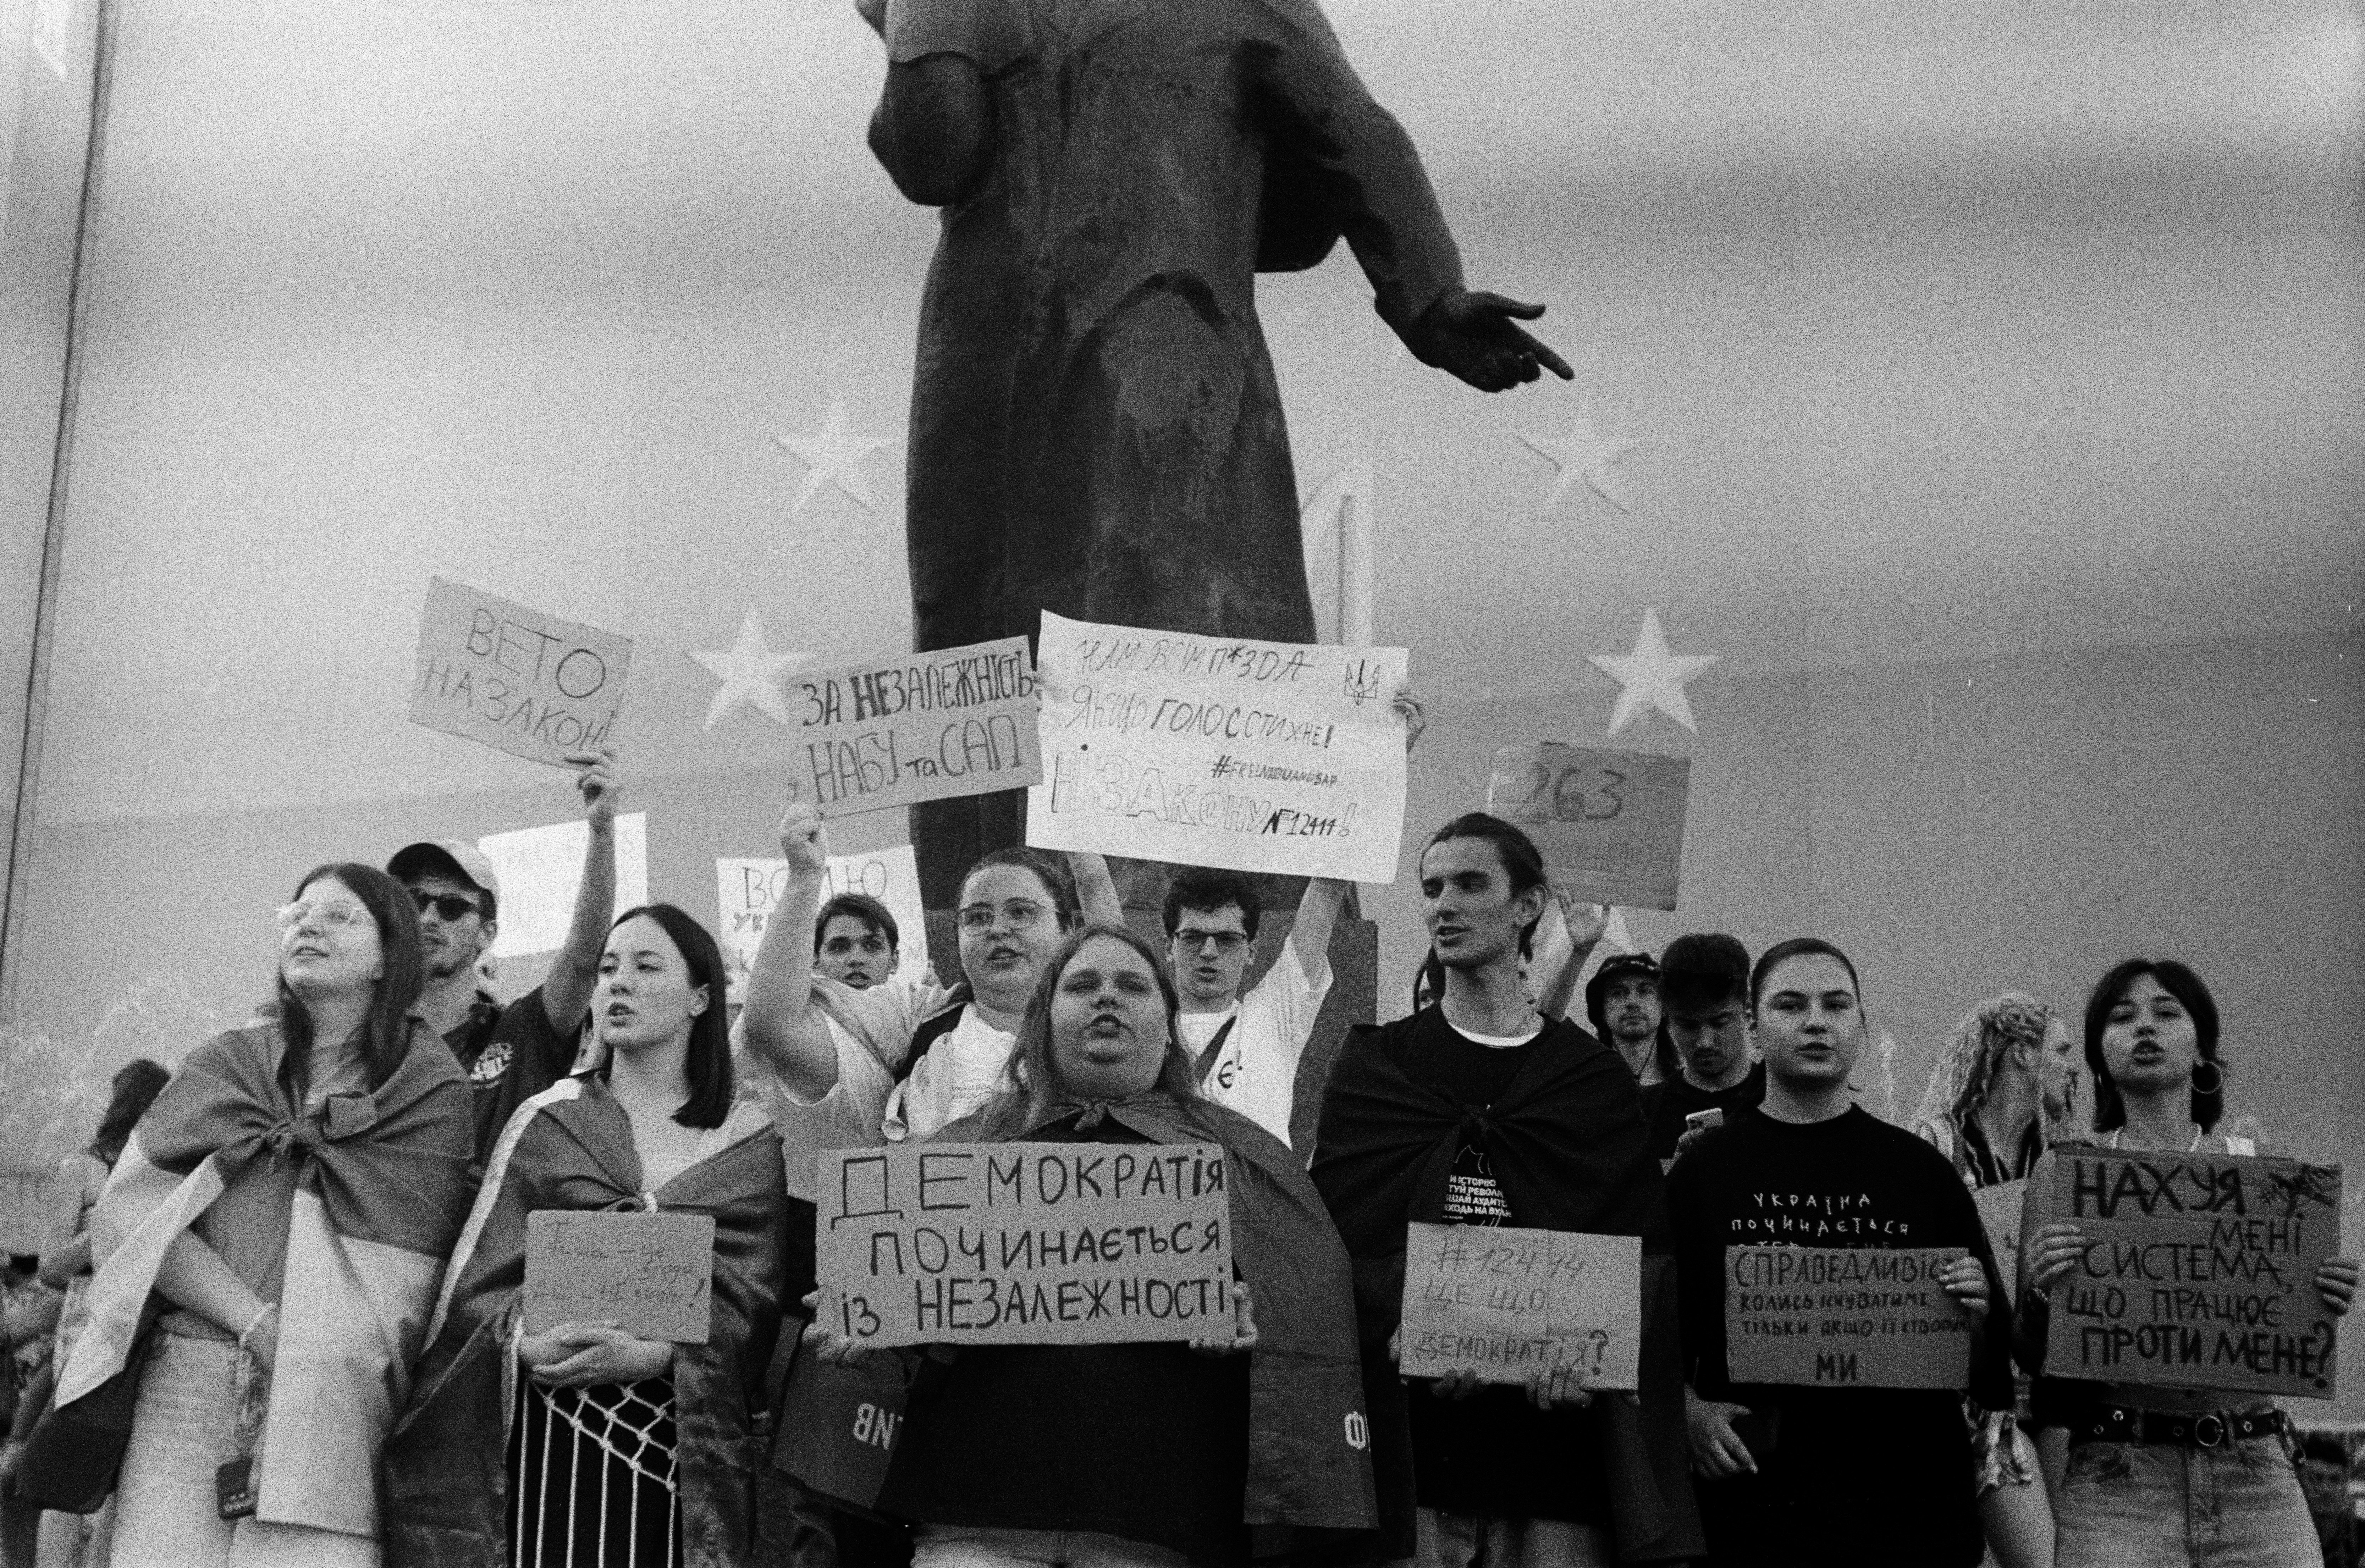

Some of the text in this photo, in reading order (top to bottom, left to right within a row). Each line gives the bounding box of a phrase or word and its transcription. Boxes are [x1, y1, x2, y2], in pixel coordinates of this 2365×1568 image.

[465, 606, 606, 700] ВЕТО
[1074, 640, 1141, 675] НАМ
[423, 655, 473, 708] НА
[803, 651, 1033, 727] ЗА НЕЗАЛЕЖНІСТЬ
[1065, 685, 1334, 749] ЯКЩО ГОЛОС СТИХНЕ!
[807, 730, 899, 803] НАБУ
[940, 715, 1022, 776] САП
[1092, 754, 1271, 833] ЗАКОНУ
[830, 1149, 1223, 1231] ДЕМОКРАТІЯ
[1458, 1176, 1496, 1187] ІСТОРІЮ
[1753, 1192, 1870, 1215] УКРАЇНА
[2073, 1159, 2245, 1218] НАХУЯ
[869, 1220, 1220, 1276] ПОЧИНАЄТЬСЯ
[1731, 1215, 1908, 1237] ПОЧИНАЄТЬСЯ
[2210, 1211, 2304, 1256] МЕНІ
[2082, 1242, 2293, 1294] СИСТЕМА,
[914, 1266, 1225, 1331] НЕЗАЛЕЖНОСТІ
[1423, 1278, 1546, 1314] ЦЕ ЩО
[1740, 1291, 1815, 1314] КОЛИСЬ
[2066, 1286, 2282, 1327] ЩО ПРАЦЮЄ
[1741, 1318, 1809, 1336] ТІЛЬКИ
[1821, 1318, 1874, 1337] ЯКЩО
[1815, 1353, 1857, 1382] МИ
[2081, 1320, 2336, 1389] ПРОТИ МЕНЕ?
